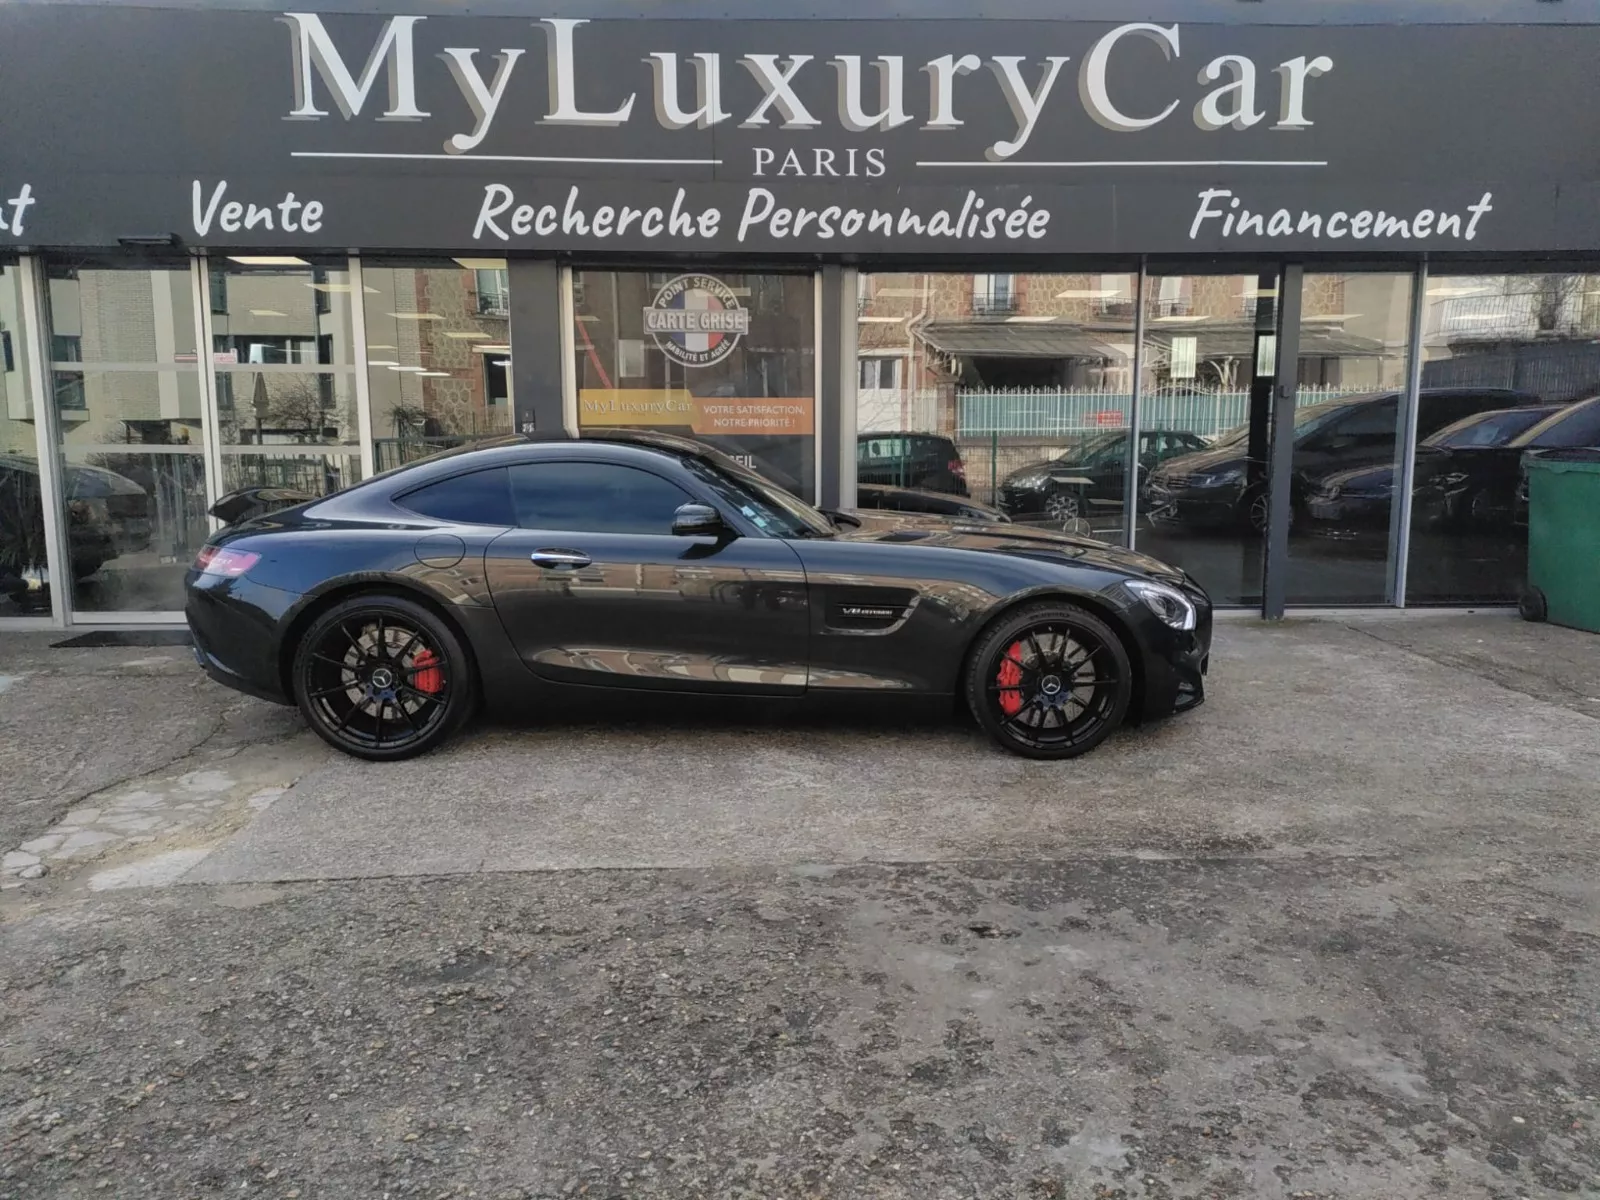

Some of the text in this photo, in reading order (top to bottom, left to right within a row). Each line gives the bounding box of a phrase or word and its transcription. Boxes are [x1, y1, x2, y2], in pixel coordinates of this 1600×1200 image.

[278, 12, 1333, 159] MyLuxuryCar
[753, 147, 887, 177] PARIS
[192, 179, 324, 237] Vente
[472, 183, 1051, 242] Recherche Personnalisée
[1189, 187, 1493, 241] Financement
[658, 277, 736, 309] POINT SERVICE
[647, 311, 744, 330] CARTE GRISE
[703, 405, 805, 416] VOTRE SATISFACTION,
[713, 418, 746, 427] NOTRE
[748, 416, 790, 427] PRIORITÉ
